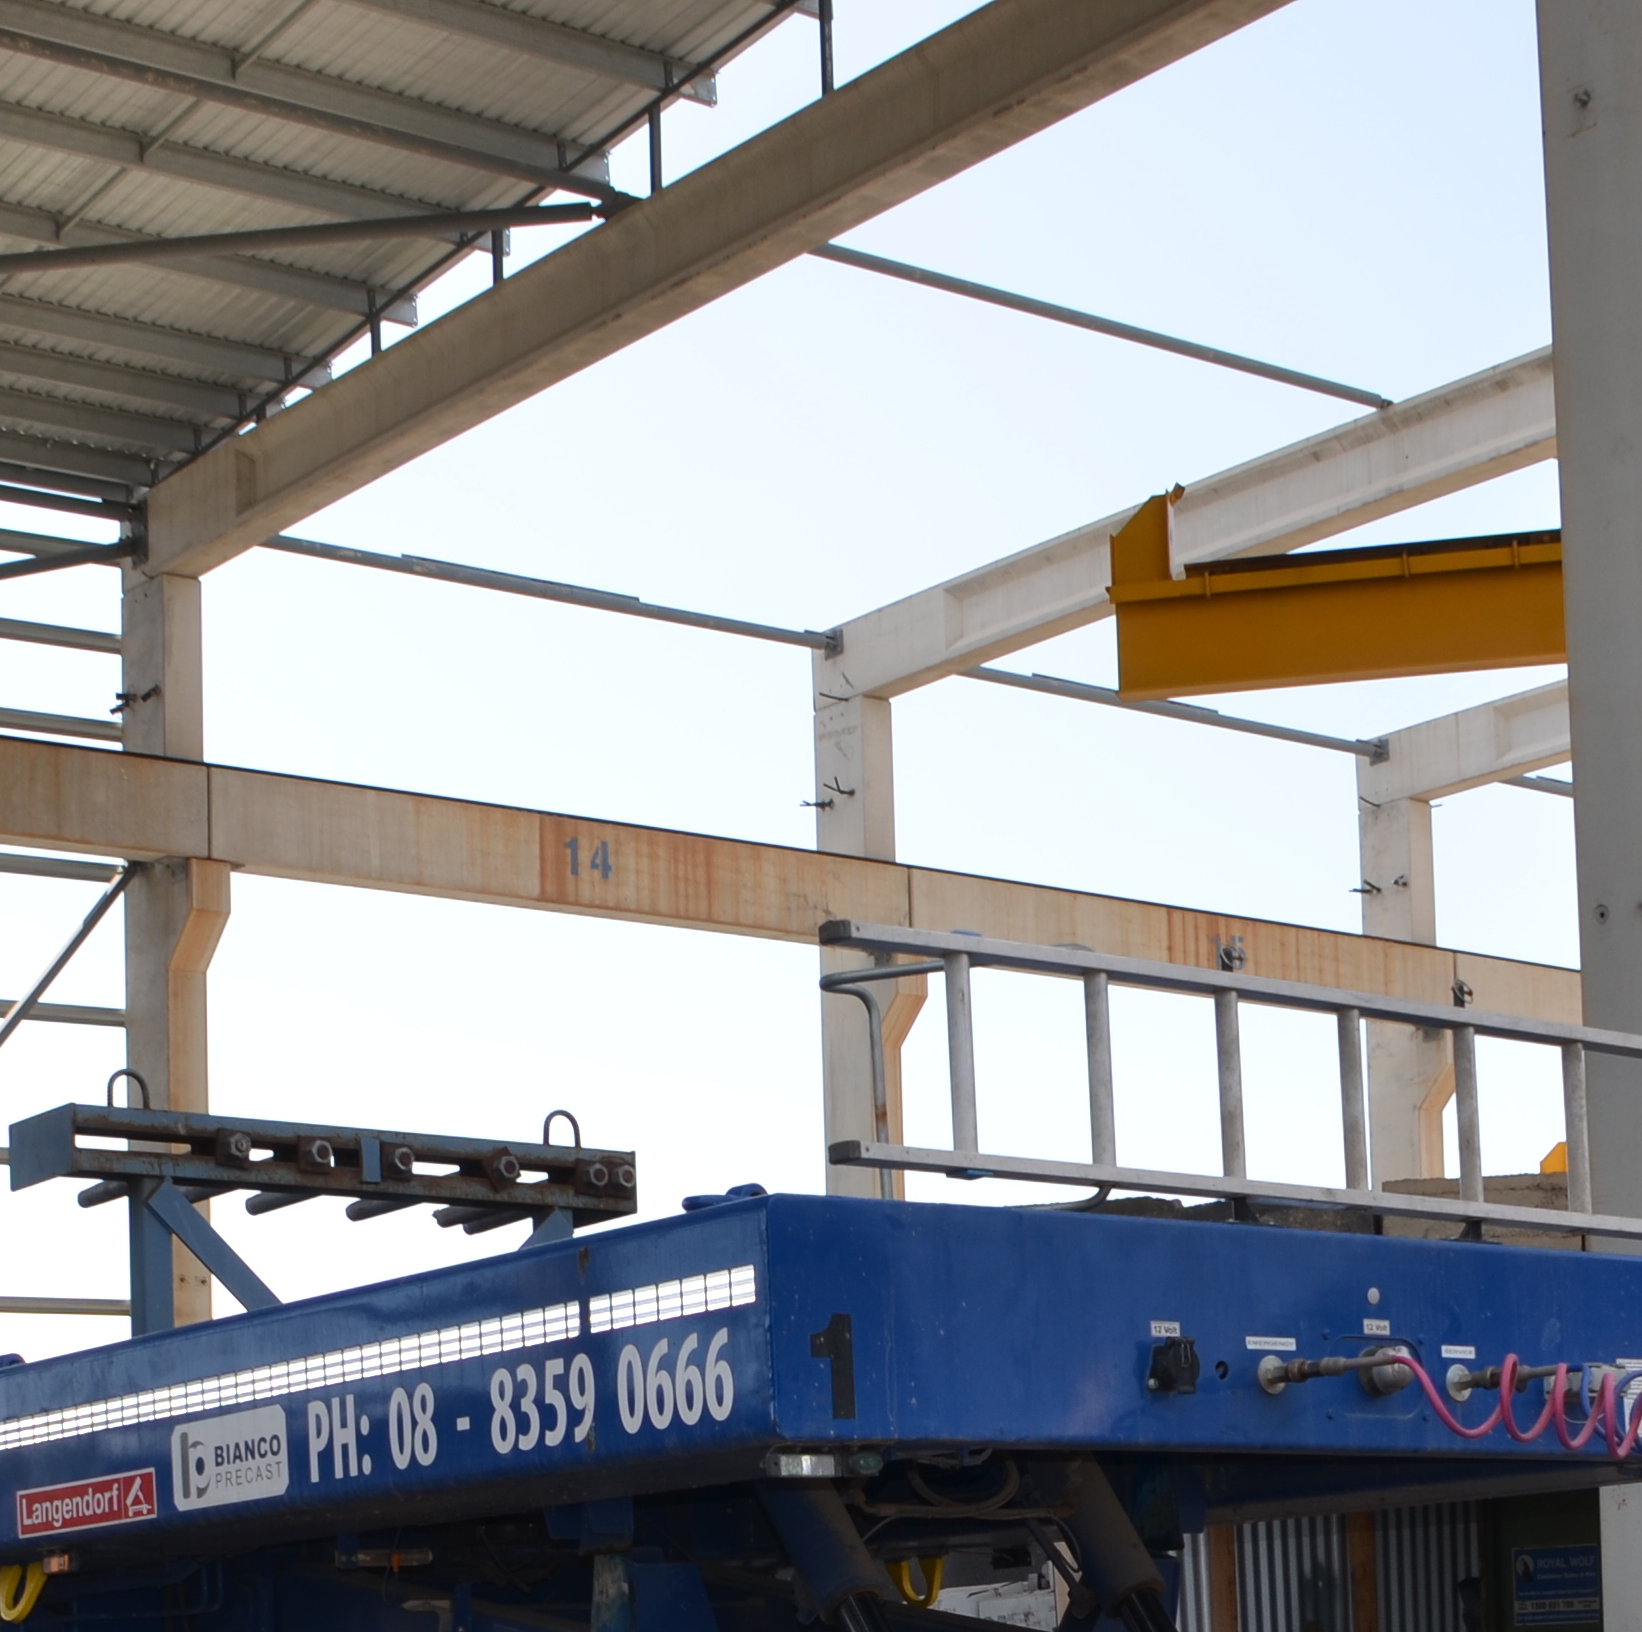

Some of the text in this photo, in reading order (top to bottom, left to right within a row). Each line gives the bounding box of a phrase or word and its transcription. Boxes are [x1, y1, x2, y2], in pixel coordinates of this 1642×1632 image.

[561, 836, 613, 880] 14
[1153, 1324, 1178, 1335] 12 Volt
[1365, 1322, 1388, 1333] 12 Volt
[810, 1313, 856, 1420] 1
[308, 1393, 372, 1483] PH:
[389, 1382, 437, 1470] 08
[490, 1353, 595, 1454] 8359
[617, 1327, 734, 1434] 0666
[214, 1434, 282, 1467] BIANCO
[215, 1461, 284, 1489] PRECAST
[22, 1483, 119, 1527] Langendorf
[1537, 1555, 1595, 1569] ROYAL WOLF
